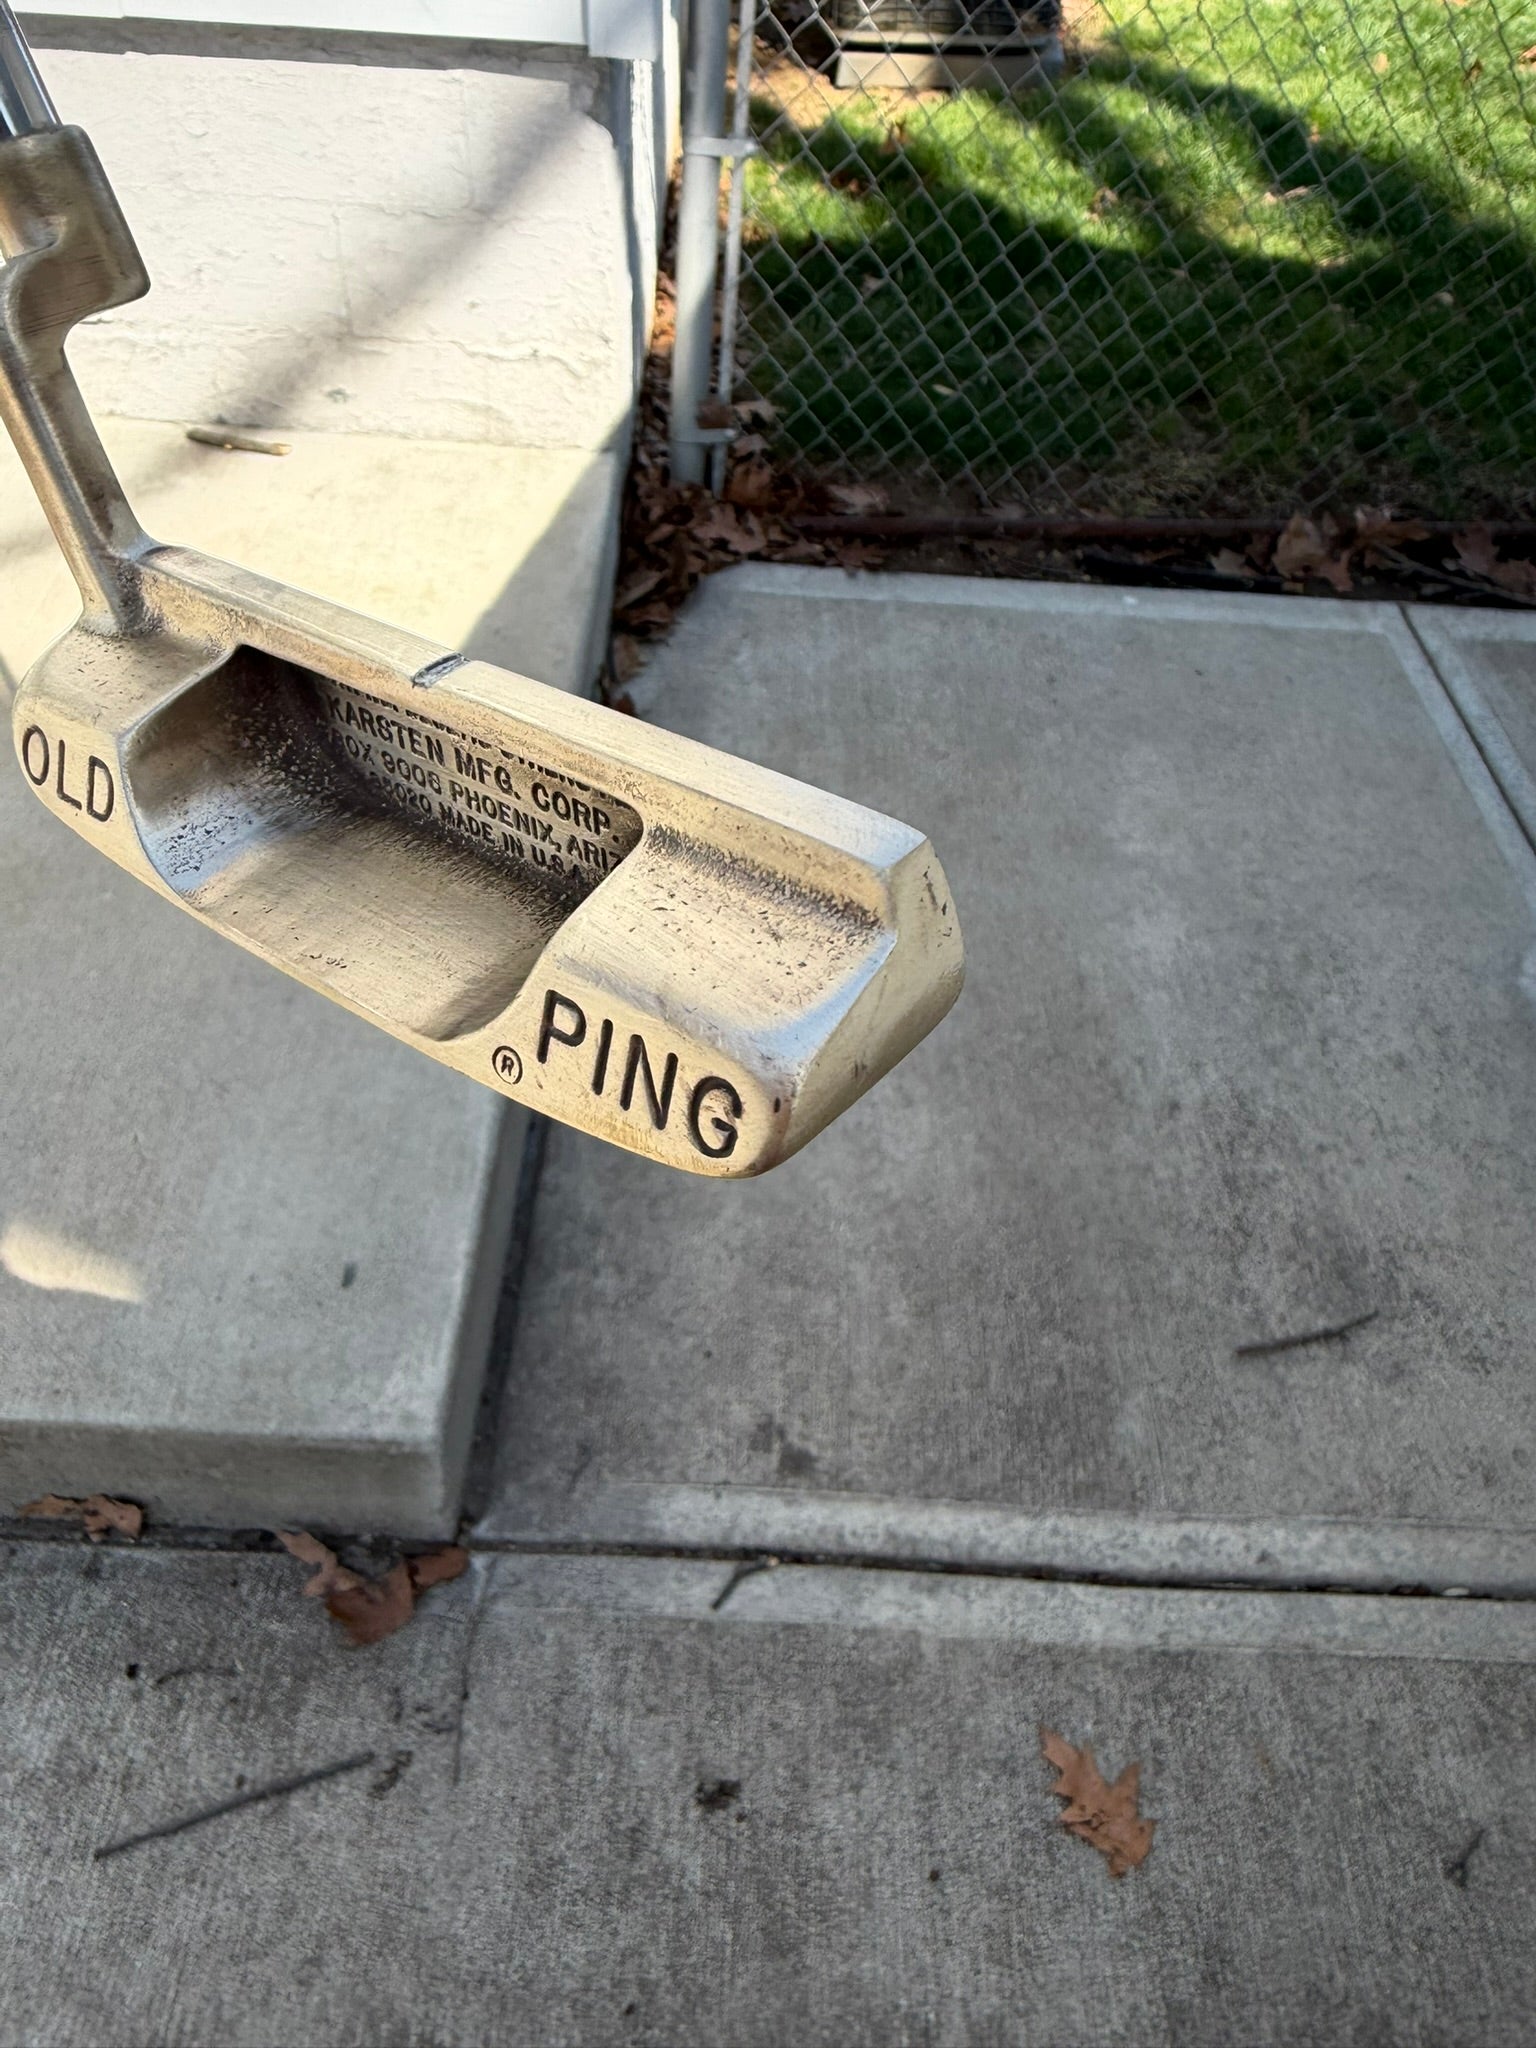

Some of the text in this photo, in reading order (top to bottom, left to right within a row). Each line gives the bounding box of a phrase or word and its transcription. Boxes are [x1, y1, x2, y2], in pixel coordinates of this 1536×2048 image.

[22, 724, 115, 822] OLD
[326, 695, 446, 768] KARSTEN
[453, 747, 522, 801] MFG.
[531, 782, 620, 844] CORP.
[448, 779, 562, 853] PHOENIX,
[438, 801, 497, 846] MADE
[501, 831, 525, 859] IN
[537, 988, 742, 1158] PING
